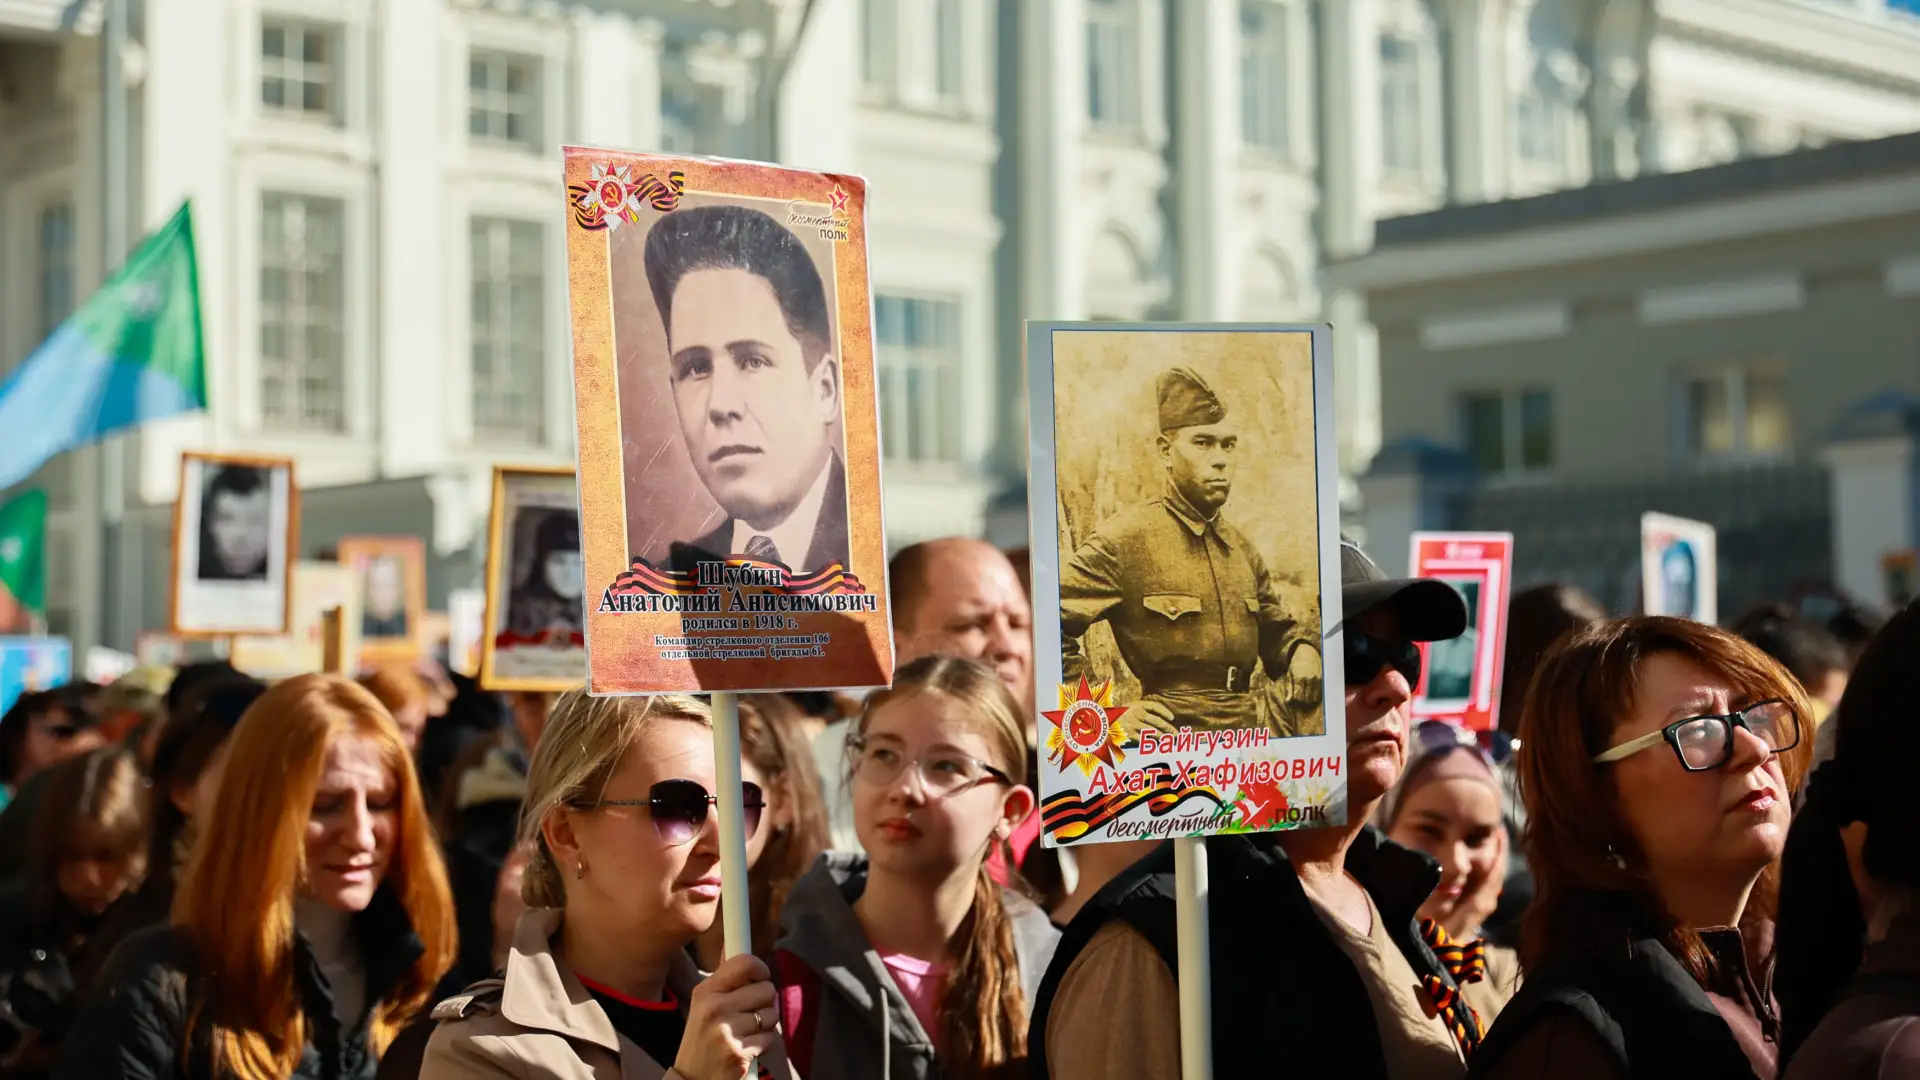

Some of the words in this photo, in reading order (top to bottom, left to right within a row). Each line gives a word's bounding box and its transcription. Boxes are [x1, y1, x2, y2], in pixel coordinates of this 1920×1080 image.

[820, 229, 848, 240] ПОЛК
[697, 561, 783, 591] Шубин
[599, 590, 722, 612] Анатолий
[728, 592, 878, 612] Анисимович
[682, 618, 738, 632] родился
[742, 619, 750, 629] в
[754, 615, 784, 629] 1918
[787, 619, 799, 629] г.
[655, 635, 703, 647] Командир
[705, 636, 762, 647] стрелкового
[764, 635, 811, 646] отделения
[814, 633, 829, 643] 106
[661, 650, 710, 659] отдельной
[712, 648, 765, 660] стрелковой
[771, 648, 813, 658] бригады
[812, 647, 825, 658] 61.
[1139, 727, 1270, 757] Байгузин
[1087, 766, 1164, 795] Ахат
[1171, 755, 1342, 793] Хафизович
[1107, 793, 1236, 838] бессмертный
[1275, 804, 1325, 823] ПОЛК
